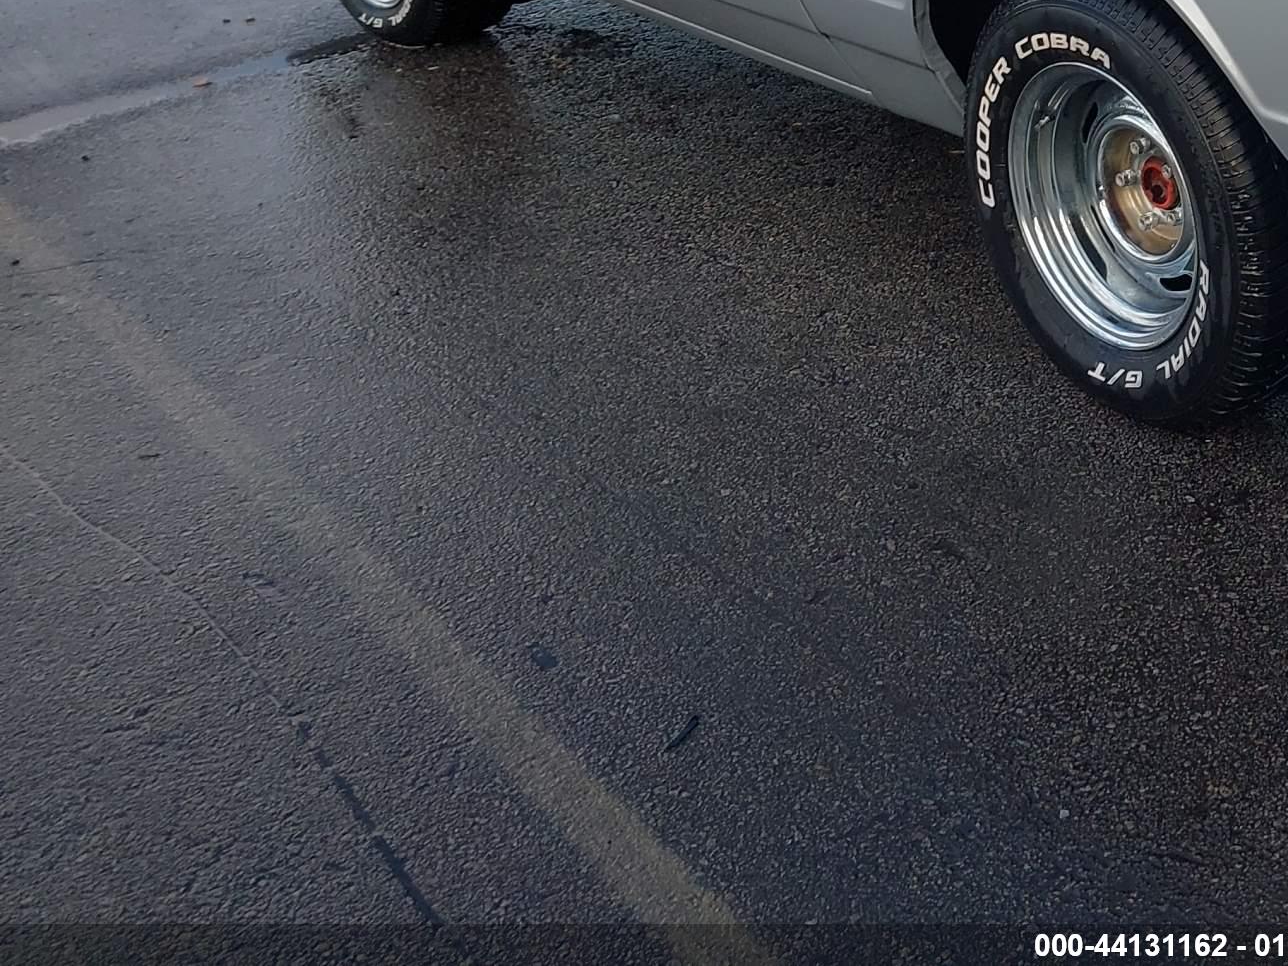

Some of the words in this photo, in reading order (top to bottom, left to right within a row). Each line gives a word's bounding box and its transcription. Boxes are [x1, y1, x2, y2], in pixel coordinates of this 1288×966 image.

[358, 13, 383, 28] G/T
[974, 56, 1012, 209] COOPER
[1014, 32, 1112, 70] COBRA
[1156, 258, 1211, 380] RADIAL
[1087, 360, 1143, 390] G/T
